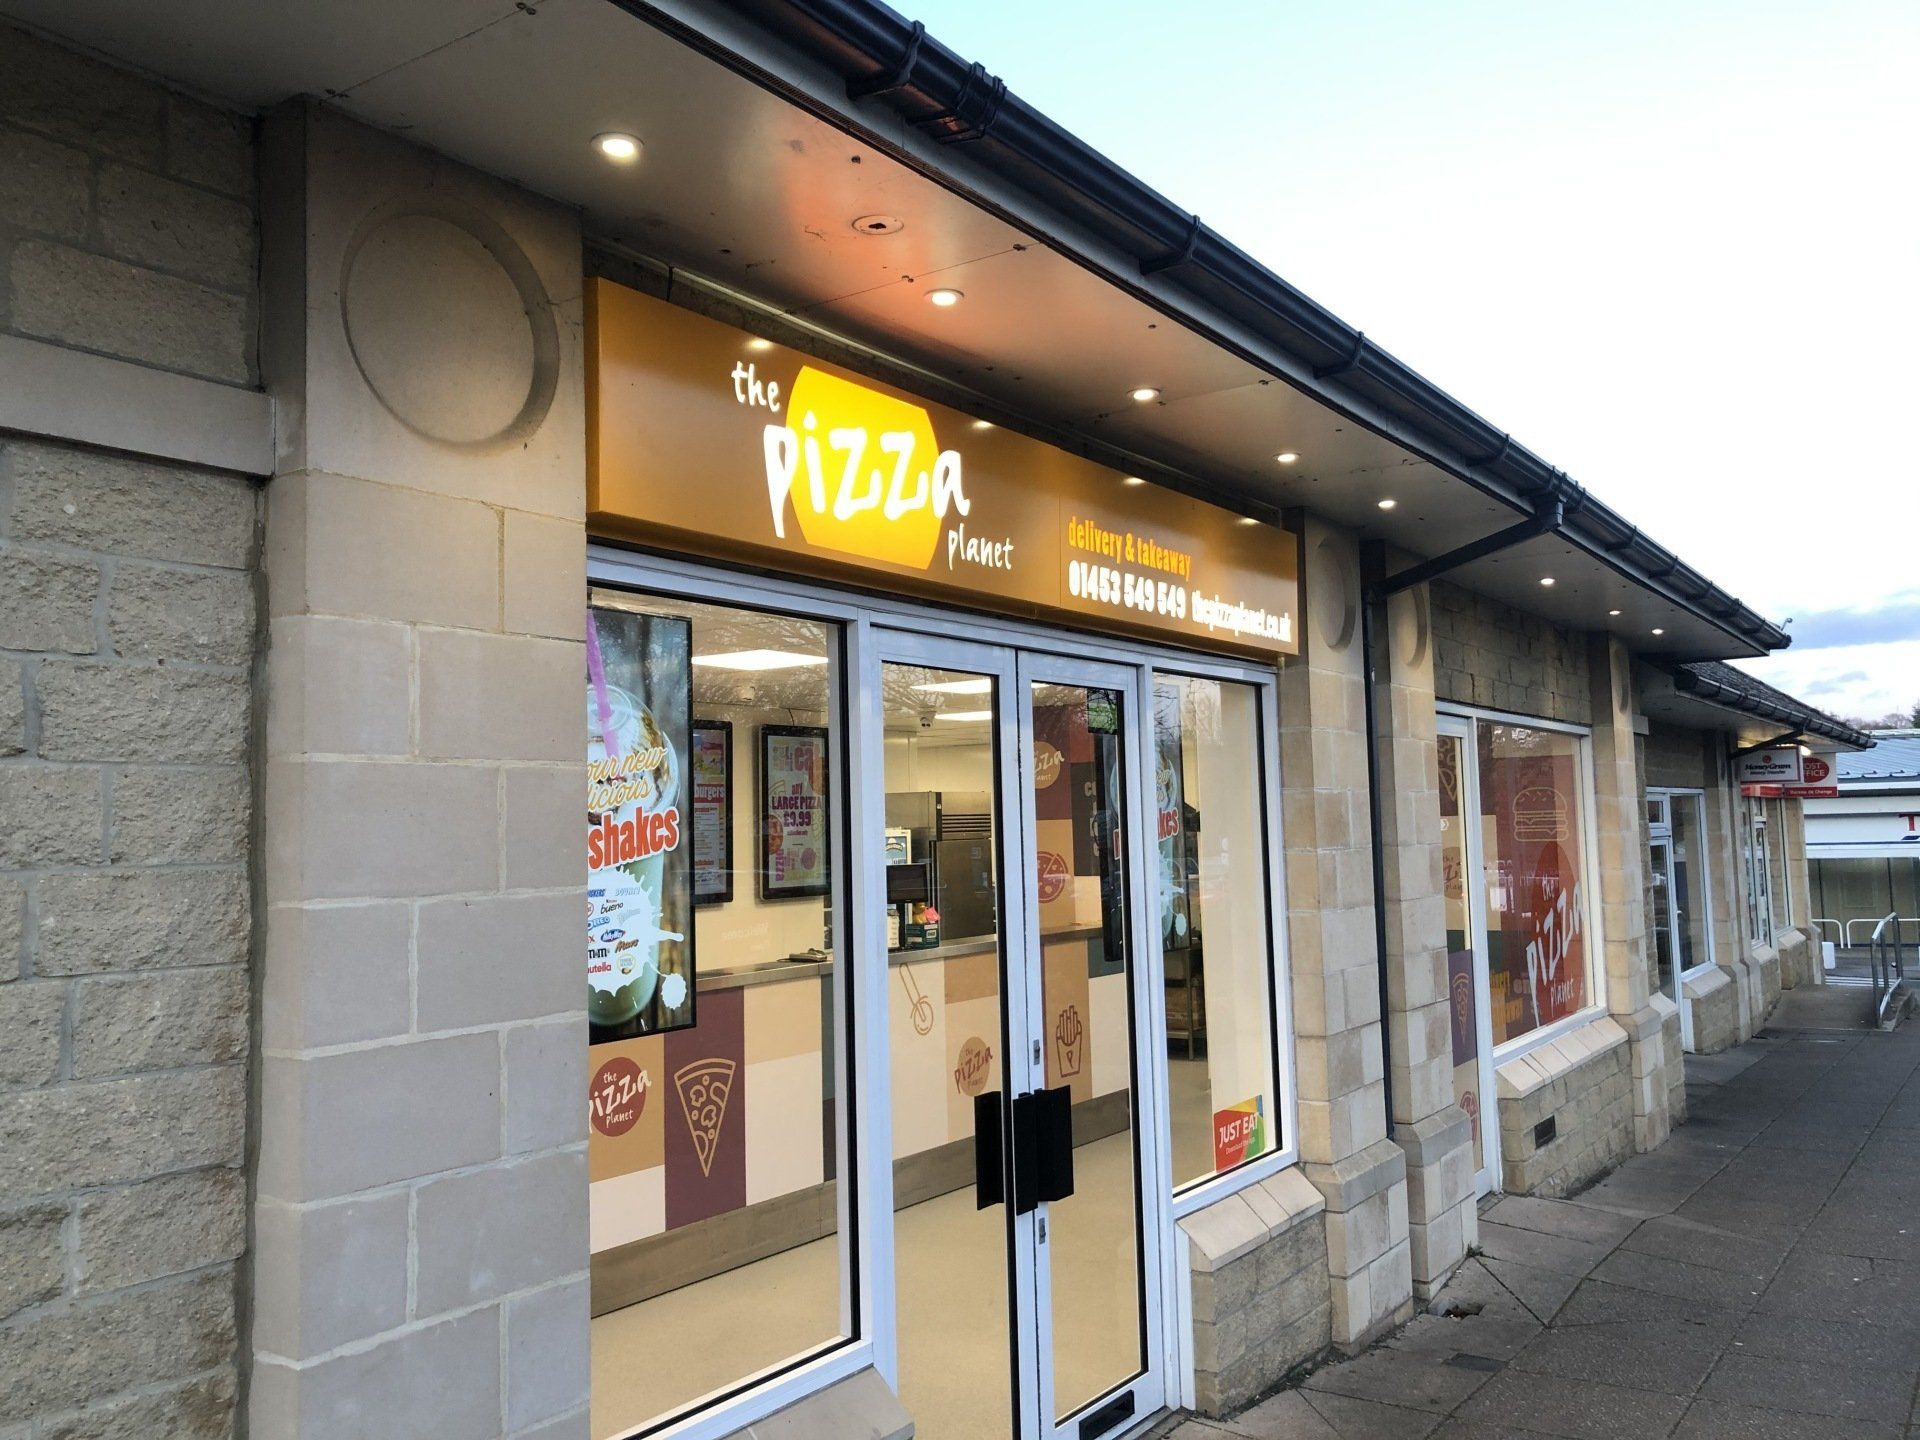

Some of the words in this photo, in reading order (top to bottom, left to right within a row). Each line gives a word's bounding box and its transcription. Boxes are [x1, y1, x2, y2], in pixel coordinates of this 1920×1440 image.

[731, 360, 780, 412] the
[763, 410, 971, 539] pizza
[947, 522, 1014, 571] planet
[1068, 516, 1122, 564] delivery
[1125, 533, 1134, 563] &
[1137, 538, 1191, 581] takeaway
[1068, 560, 1120, 605] 01453
[1123, 573, 1154, 613] 549
[1157, 581, 1186, 619] 549
[621, 747, 667, 776] new
[694, 785, 725, 800] burgers
[772, 796, 799, 810] LARGE
[800, 796, 821, 810] PIZZA
[783, 811, 812, 828] £9.99
[1542, 873, 1555, 901] the
[600, 903, 624, 914] bueno
[1526, 880, 1583, 1028] pizza
[1551, 978, 1574, 1018] planet
[603, 1072, 617, 1083] the
[954, 1046, 993, 1094] pizza
[606, 1109, 633, 1128] planet
[1219, 1120, 1241, 1149] JUST
[1243, 1113, 1258, 1135] EAT
